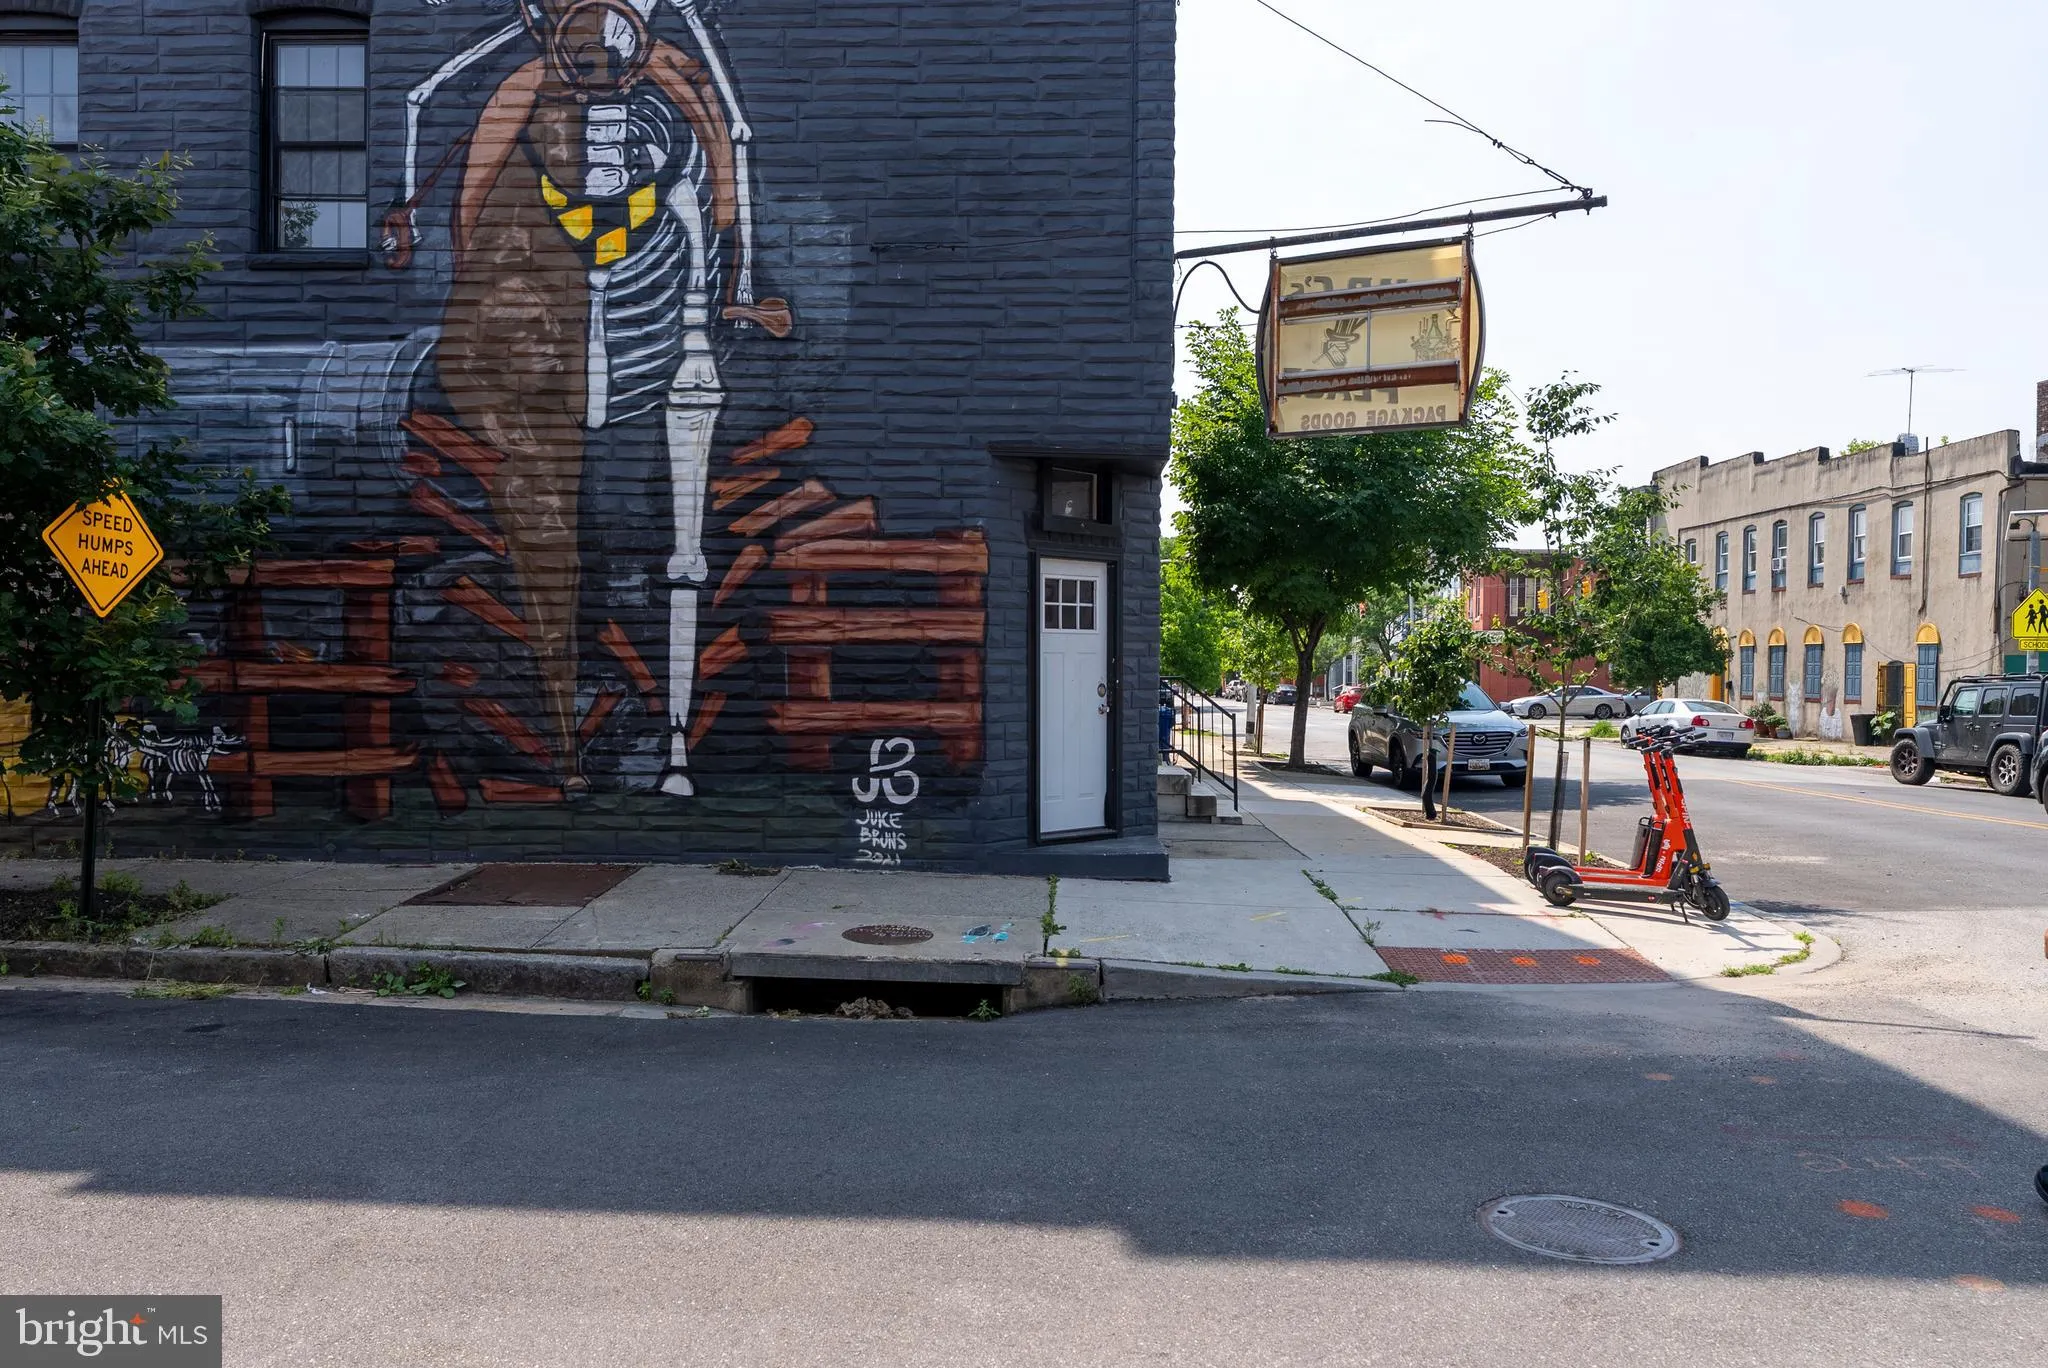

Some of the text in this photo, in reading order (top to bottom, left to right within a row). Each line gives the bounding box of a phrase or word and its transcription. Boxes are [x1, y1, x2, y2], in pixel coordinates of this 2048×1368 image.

[82, 510, 133, 533] SPEED
[78, 533, 134, 556] HUMPS
[81, 558, 129, 579] AHEAD
[1560, 1200, 1626, 1219] WATER
